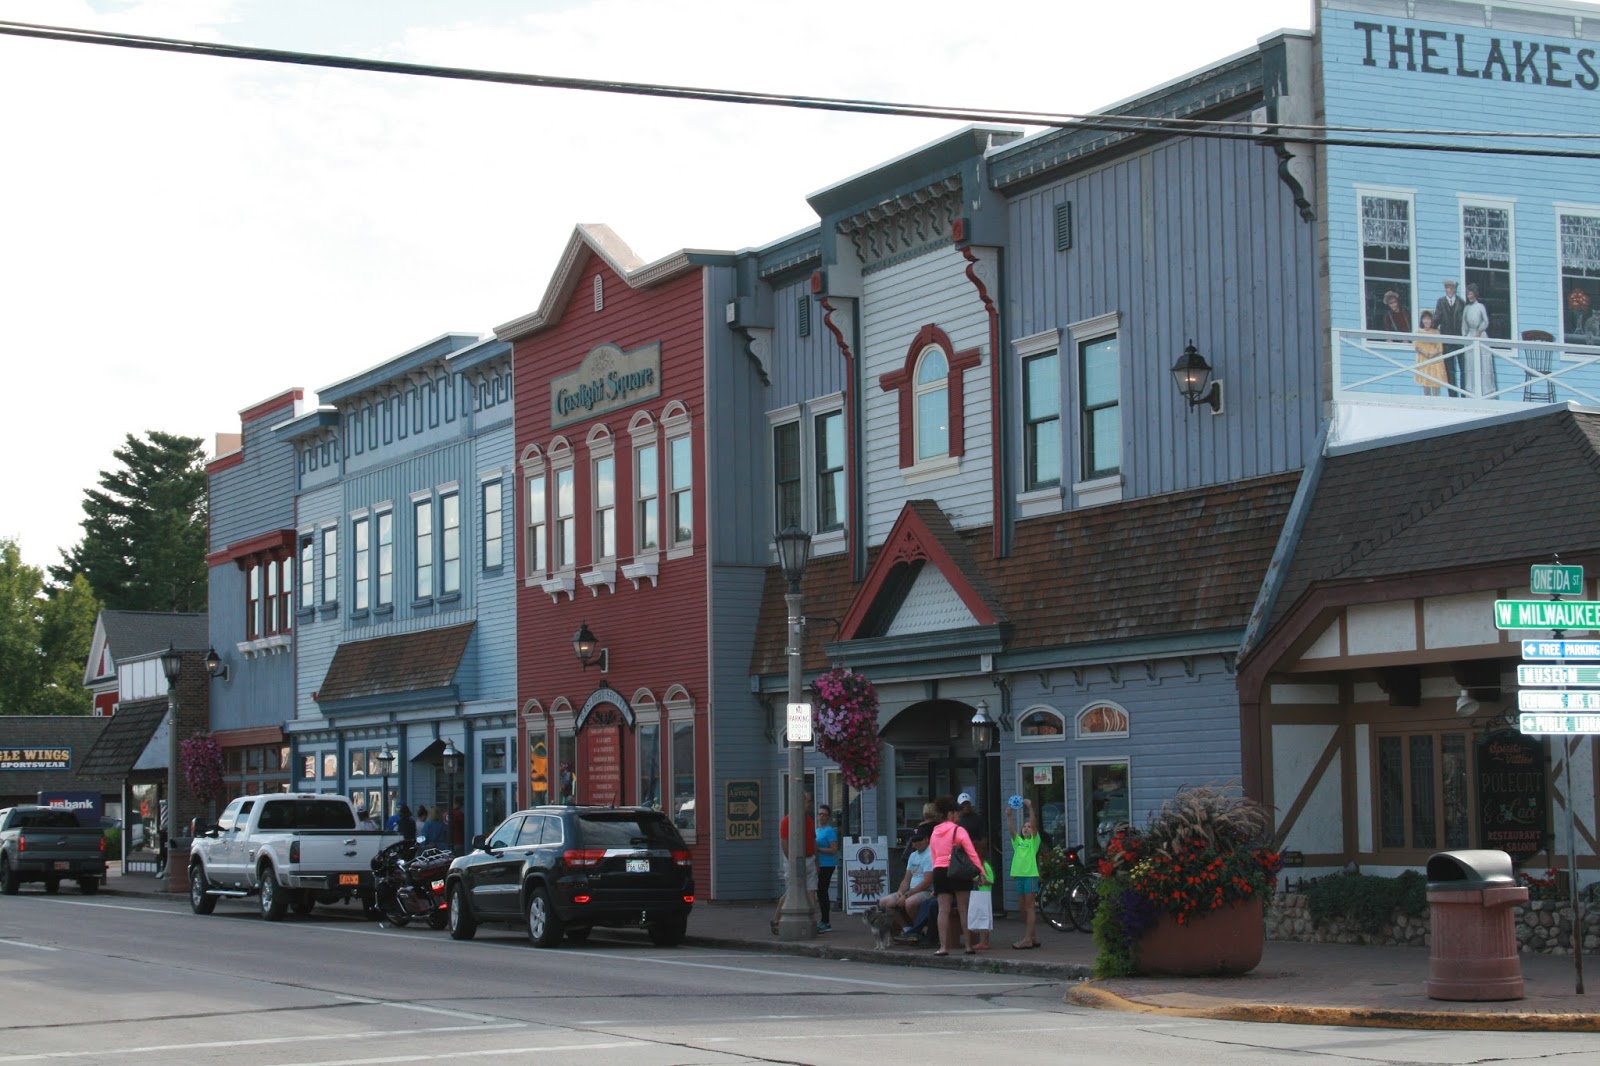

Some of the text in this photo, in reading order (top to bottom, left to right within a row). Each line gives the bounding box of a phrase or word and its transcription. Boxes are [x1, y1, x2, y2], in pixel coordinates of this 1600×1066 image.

[557, 367, 654, 416] Gaslight Square
[1533, 569, 1580, 591] ONEIDA ST
[1498, 603, 1512, 625] W
[1538, 643, 1600, 656] FREE PARKING
[1524, 667, 1578, 683] MUSEUM
[795, 705, 803, 714] NO
[789, 714, 810, 723] PARKING
[1536, 716, 1568, 731] PUBLIC
[23, 750, 70, 761] WINGS
[1482, 771, 1543, 793] POLECAT
[729, 823, 760, 837] OPEN
[1487, 830, 1542, 841] RESTAURANT
[1505, 842, 1538, 852] SALOON
[853, 883, 884, 894] OPEN
